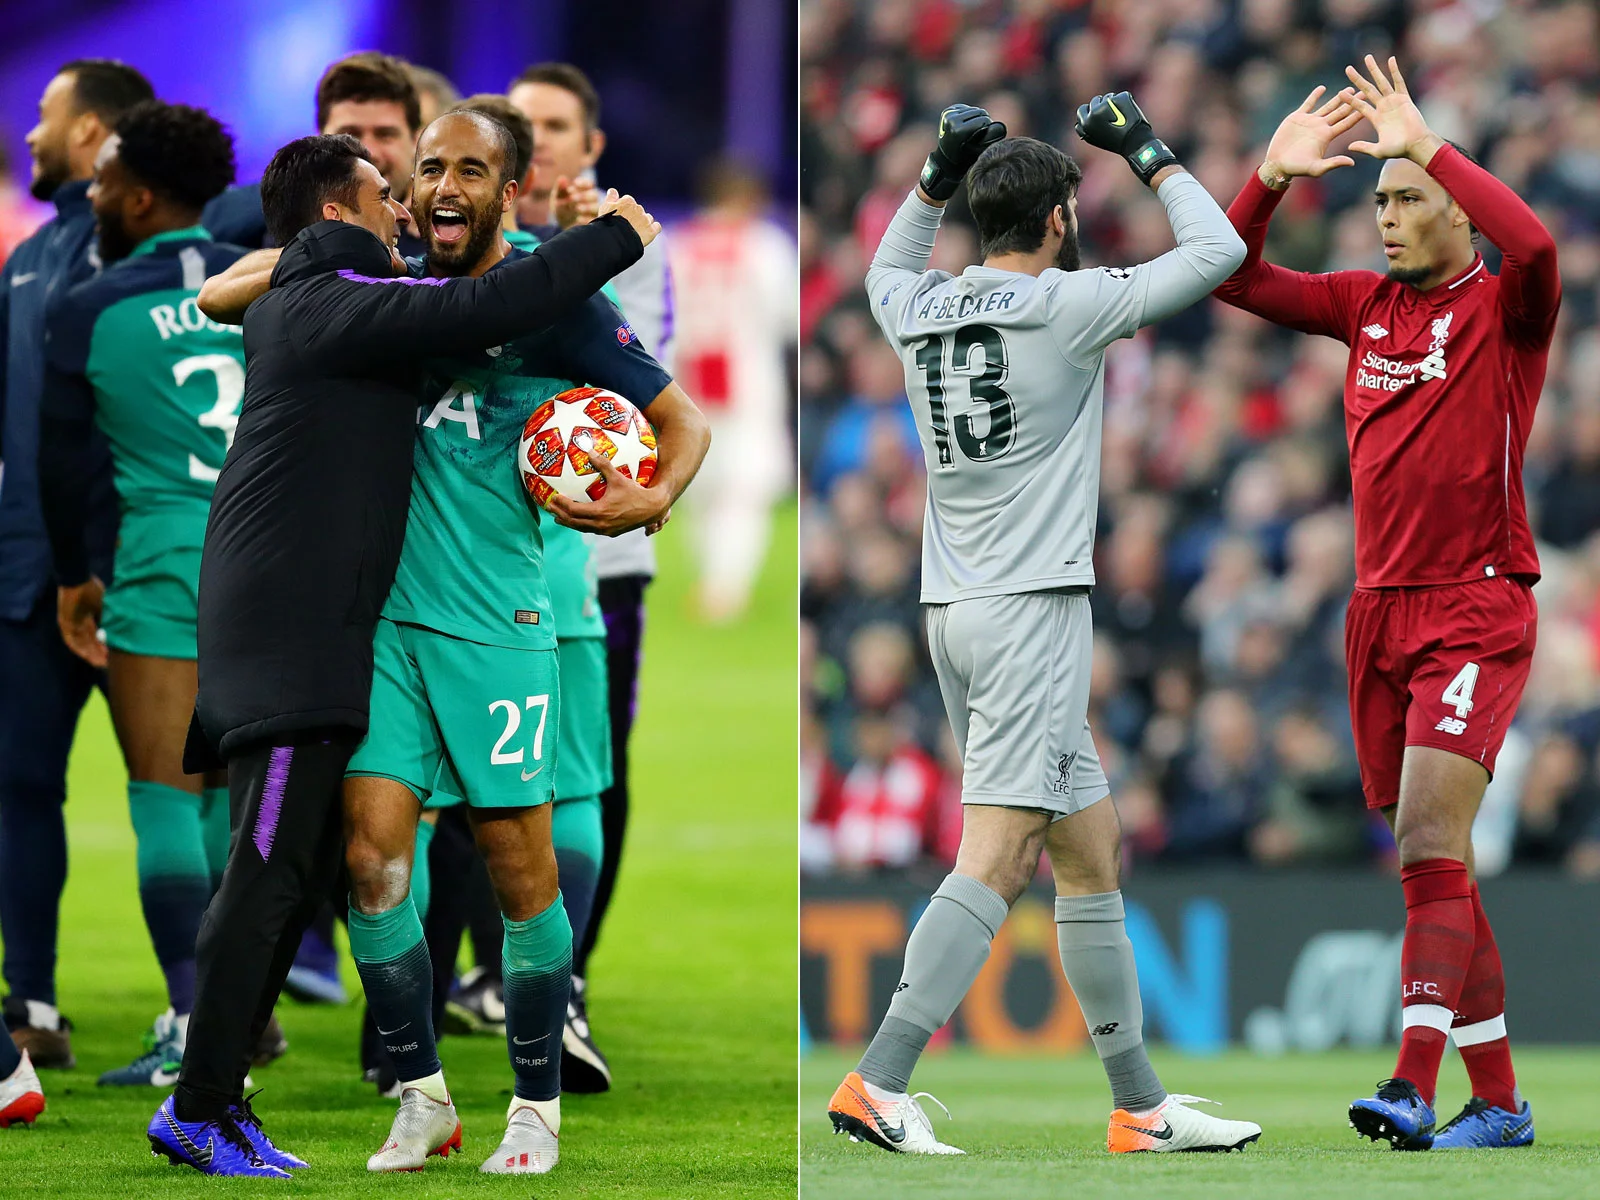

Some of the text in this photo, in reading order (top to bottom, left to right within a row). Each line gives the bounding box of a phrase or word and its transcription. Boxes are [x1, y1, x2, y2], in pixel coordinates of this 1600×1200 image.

[149, 296, 243, 340] RO
[172, 353, 246, 483] 3
[915, 325, 1018, 469] 13
[1441, 661, 1481, 719] 4
[488, 693, 550, 766] 27
[386, 1041, 419, 1054] SPURS
[515, 1055, 549, 1068] SPURS
